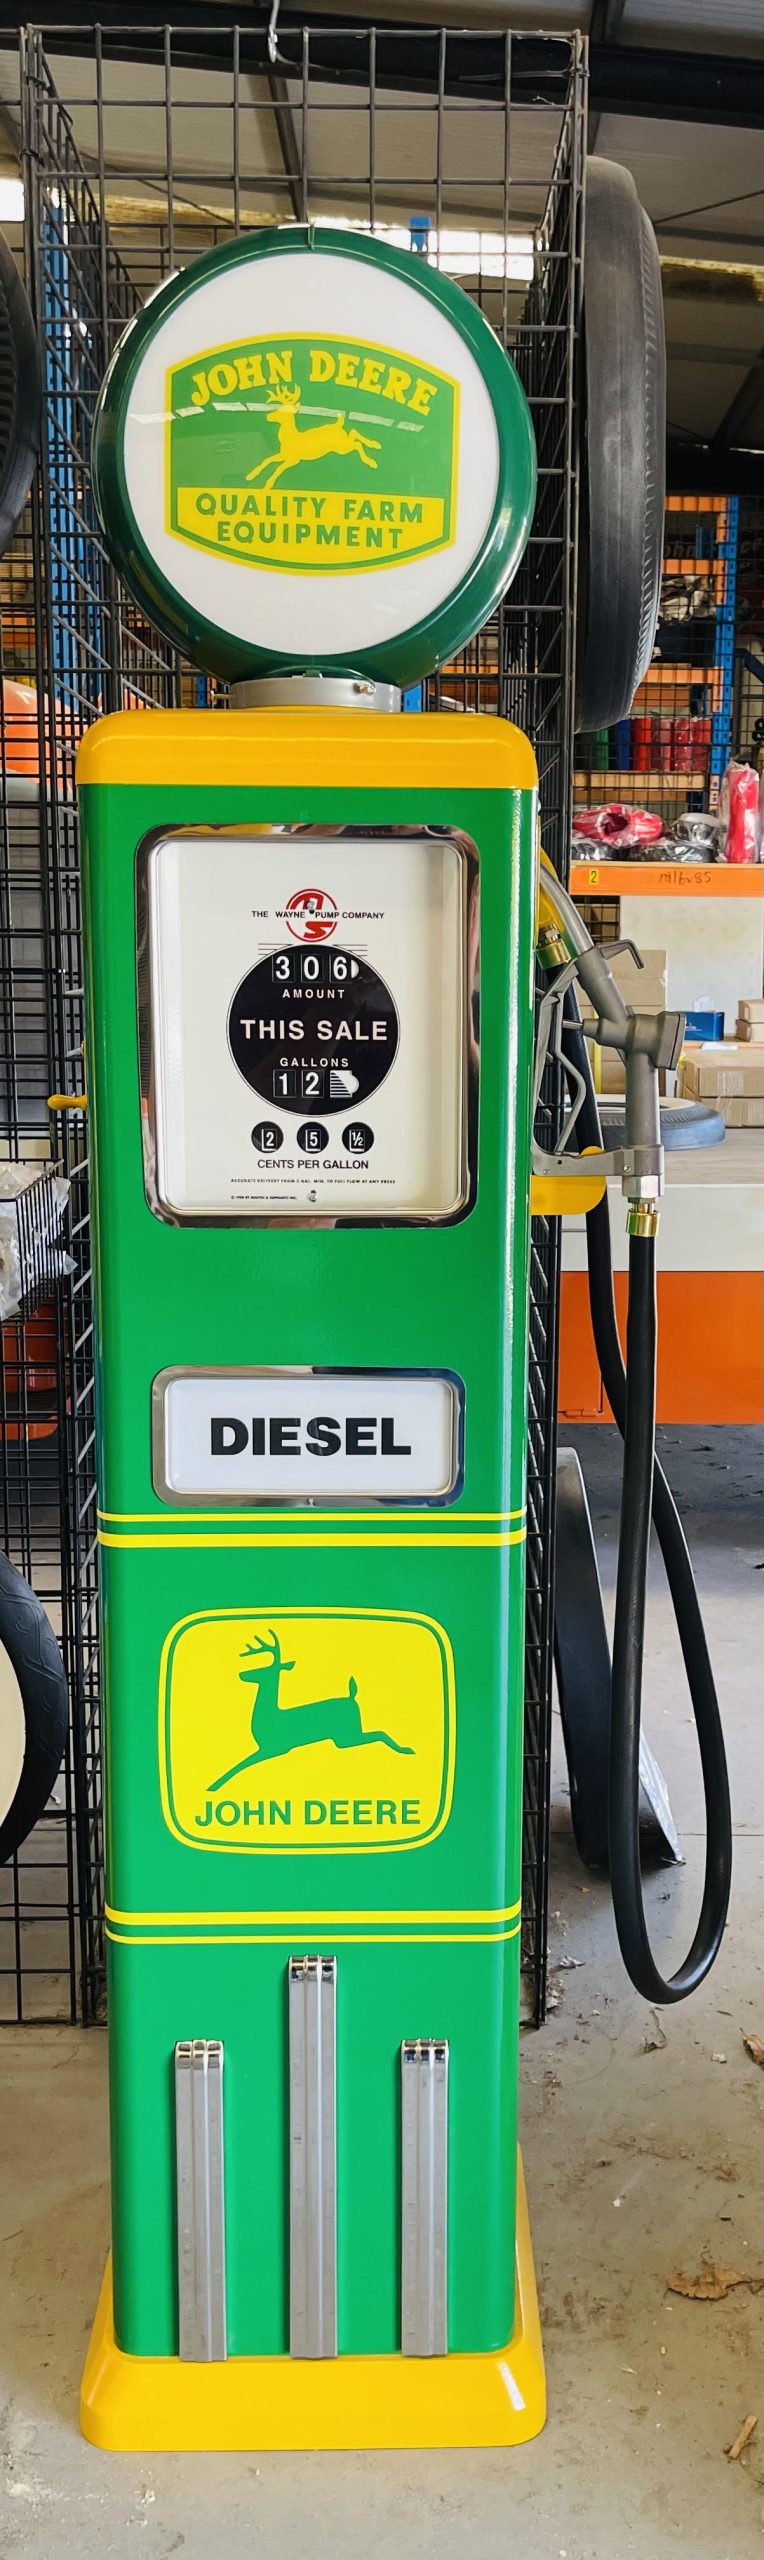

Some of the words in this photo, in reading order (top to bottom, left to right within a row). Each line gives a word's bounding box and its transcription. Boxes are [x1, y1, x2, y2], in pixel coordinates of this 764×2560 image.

[191, 350, 294, 406] JOHN
[309, 350, 439, 416] DEERE
[195, 493, 327, 519] QUALITY
[344, 499, 423, 524] FARM
[217, 520, 404, 549] EQUIPMENT
[590, 870, 598, 884] 2
[251, 910, 269, 918] THE
[275, 911, 306, 919] WAYNE
[315, 911, 340, 919] PUMP
[342, 911, 385, 920] COMPANY
[282, 988, 345, 999] AMOUNT
[239, 1019, 305, 1040] THIS
[316, 1019, 388, 1041] SALE
[279, 1057, 349, 1068] GALLONS
[265, 1131, 275, 1147] 2
[309, 1131, 319, 1147] 5
[257, 1159, 295, 1169] CENTS
[297, 1159, 320, 1169] PER
[322, 1159, 370, 1170] GALLON
[210, 1416, 412, 1457] DIESEL
[194, 1799, 292, 1827] JOHN
[304, 1799, 421, 1825] DEERE
